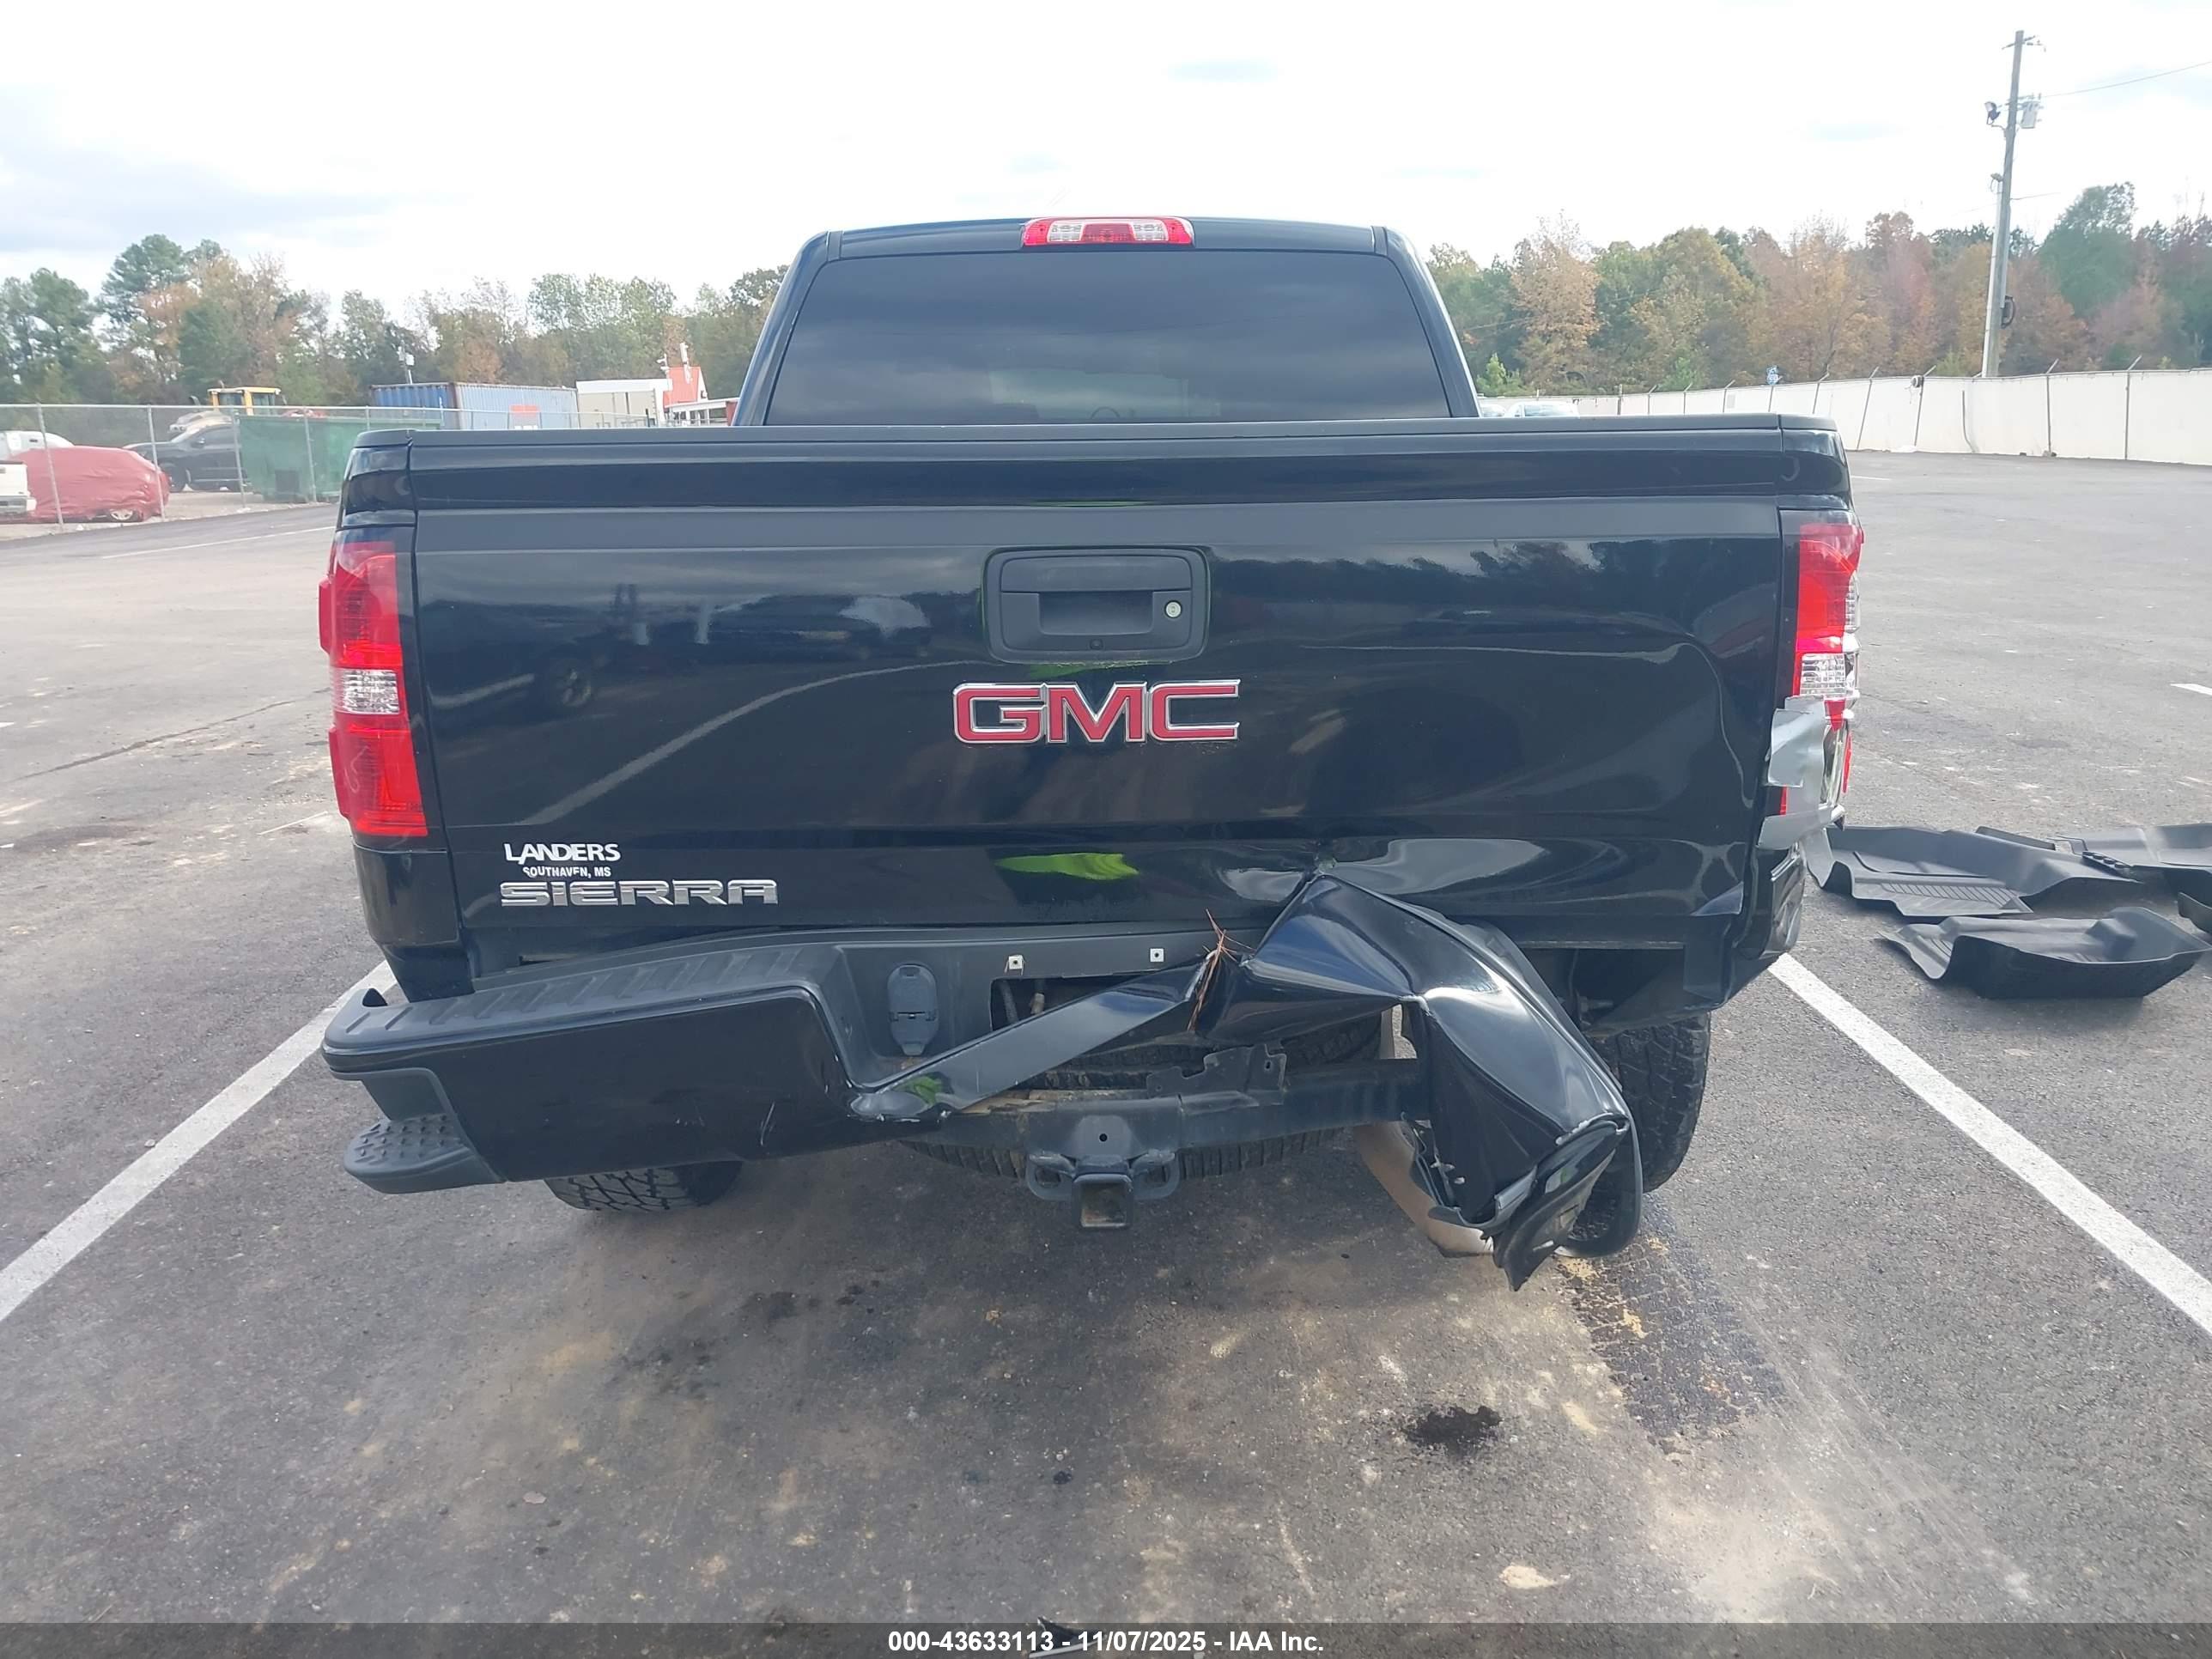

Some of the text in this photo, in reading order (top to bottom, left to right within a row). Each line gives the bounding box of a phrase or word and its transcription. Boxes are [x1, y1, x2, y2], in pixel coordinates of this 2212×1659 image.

[953, 679, 1241, 744] GMC
[504, 843, 621, 865] LANDERS
[593, 866, 611, 877] MS
[500, 879, 779, 907] SIERRA
